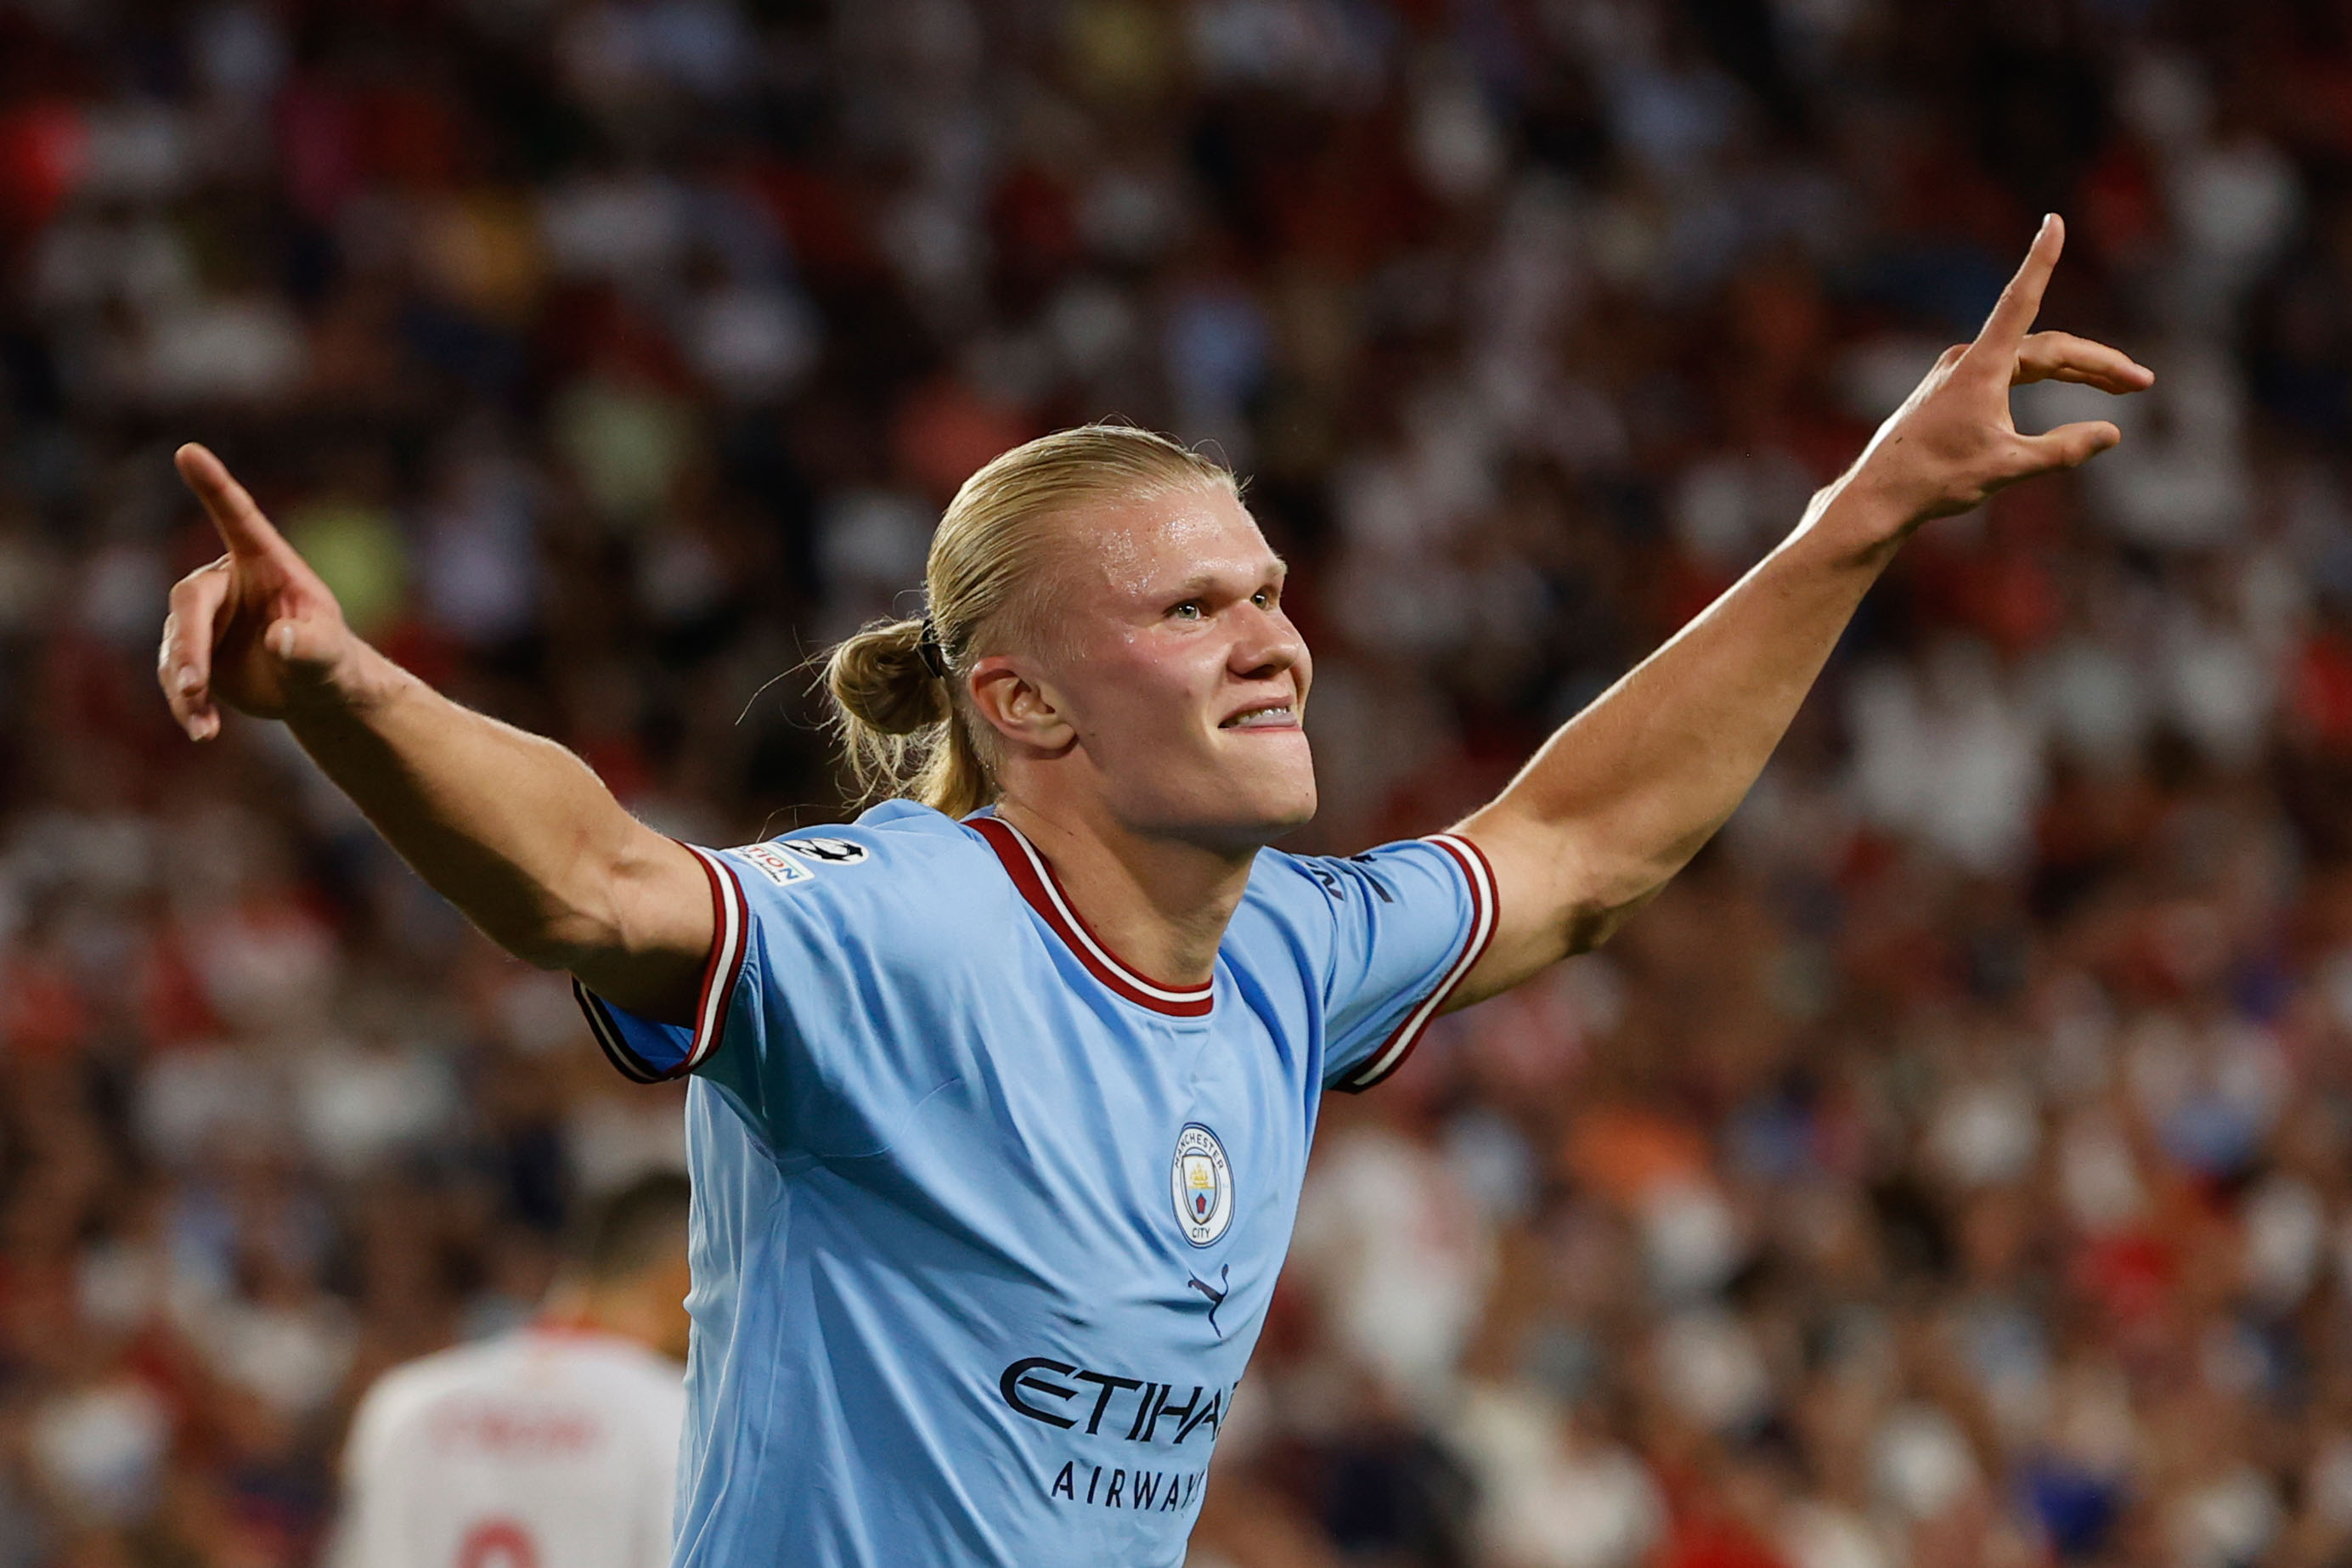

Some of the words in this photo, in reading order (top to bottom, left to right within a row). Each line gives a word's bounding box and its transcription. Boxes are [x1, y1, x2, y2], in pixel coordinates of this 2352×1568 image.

[1175, 1132, 1225, 1170] MANCHESTER
[1192, 1227, 1210, 1238] CITY
[1000, 1356, 1238, 1444] ETIHA
